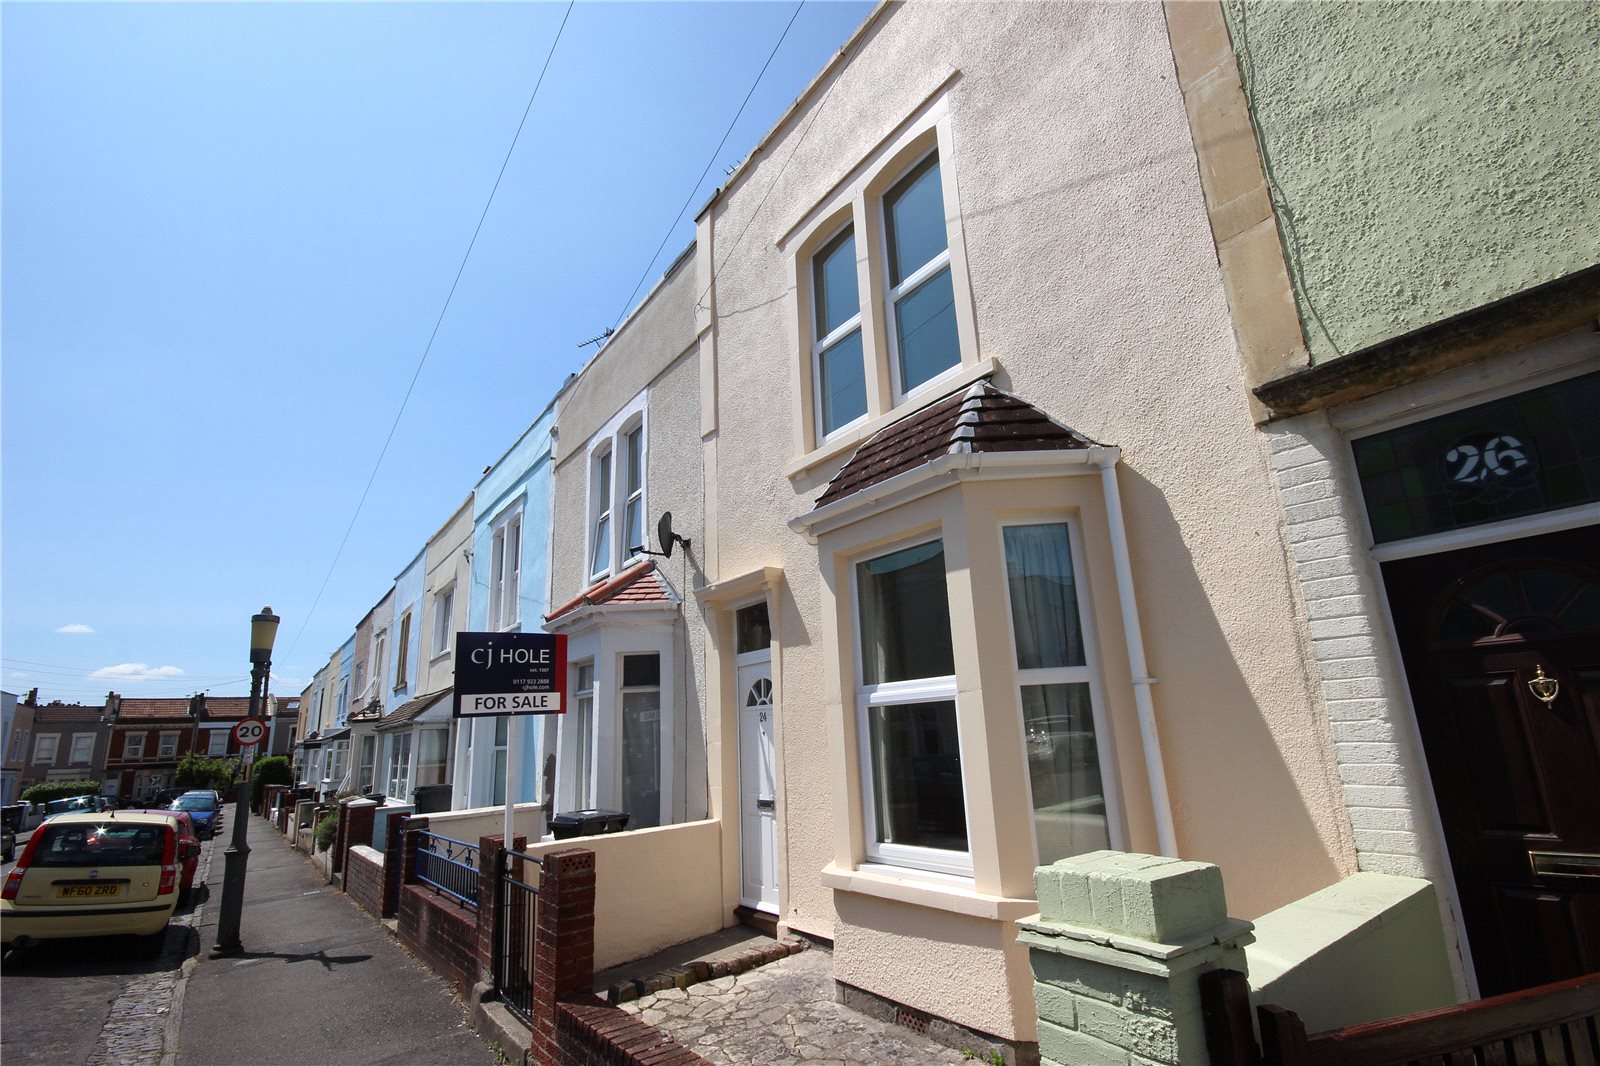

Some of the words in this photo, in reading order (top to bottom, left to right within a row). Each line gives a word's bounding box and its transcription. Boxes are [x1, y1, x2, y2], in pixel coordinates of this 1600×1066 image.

[1445, 434, 1528, 483] 26
[500, 648, 550, 664] HOLE
[475, 696, 506, 710] FOR
[512, 695, 548, 709] SALE
[759, 712, 767, 722] 24
[239, 725, 263, 738] 20
[62, 886, 92, 896] WF60
[94, 885, 117, 895] ZRD
